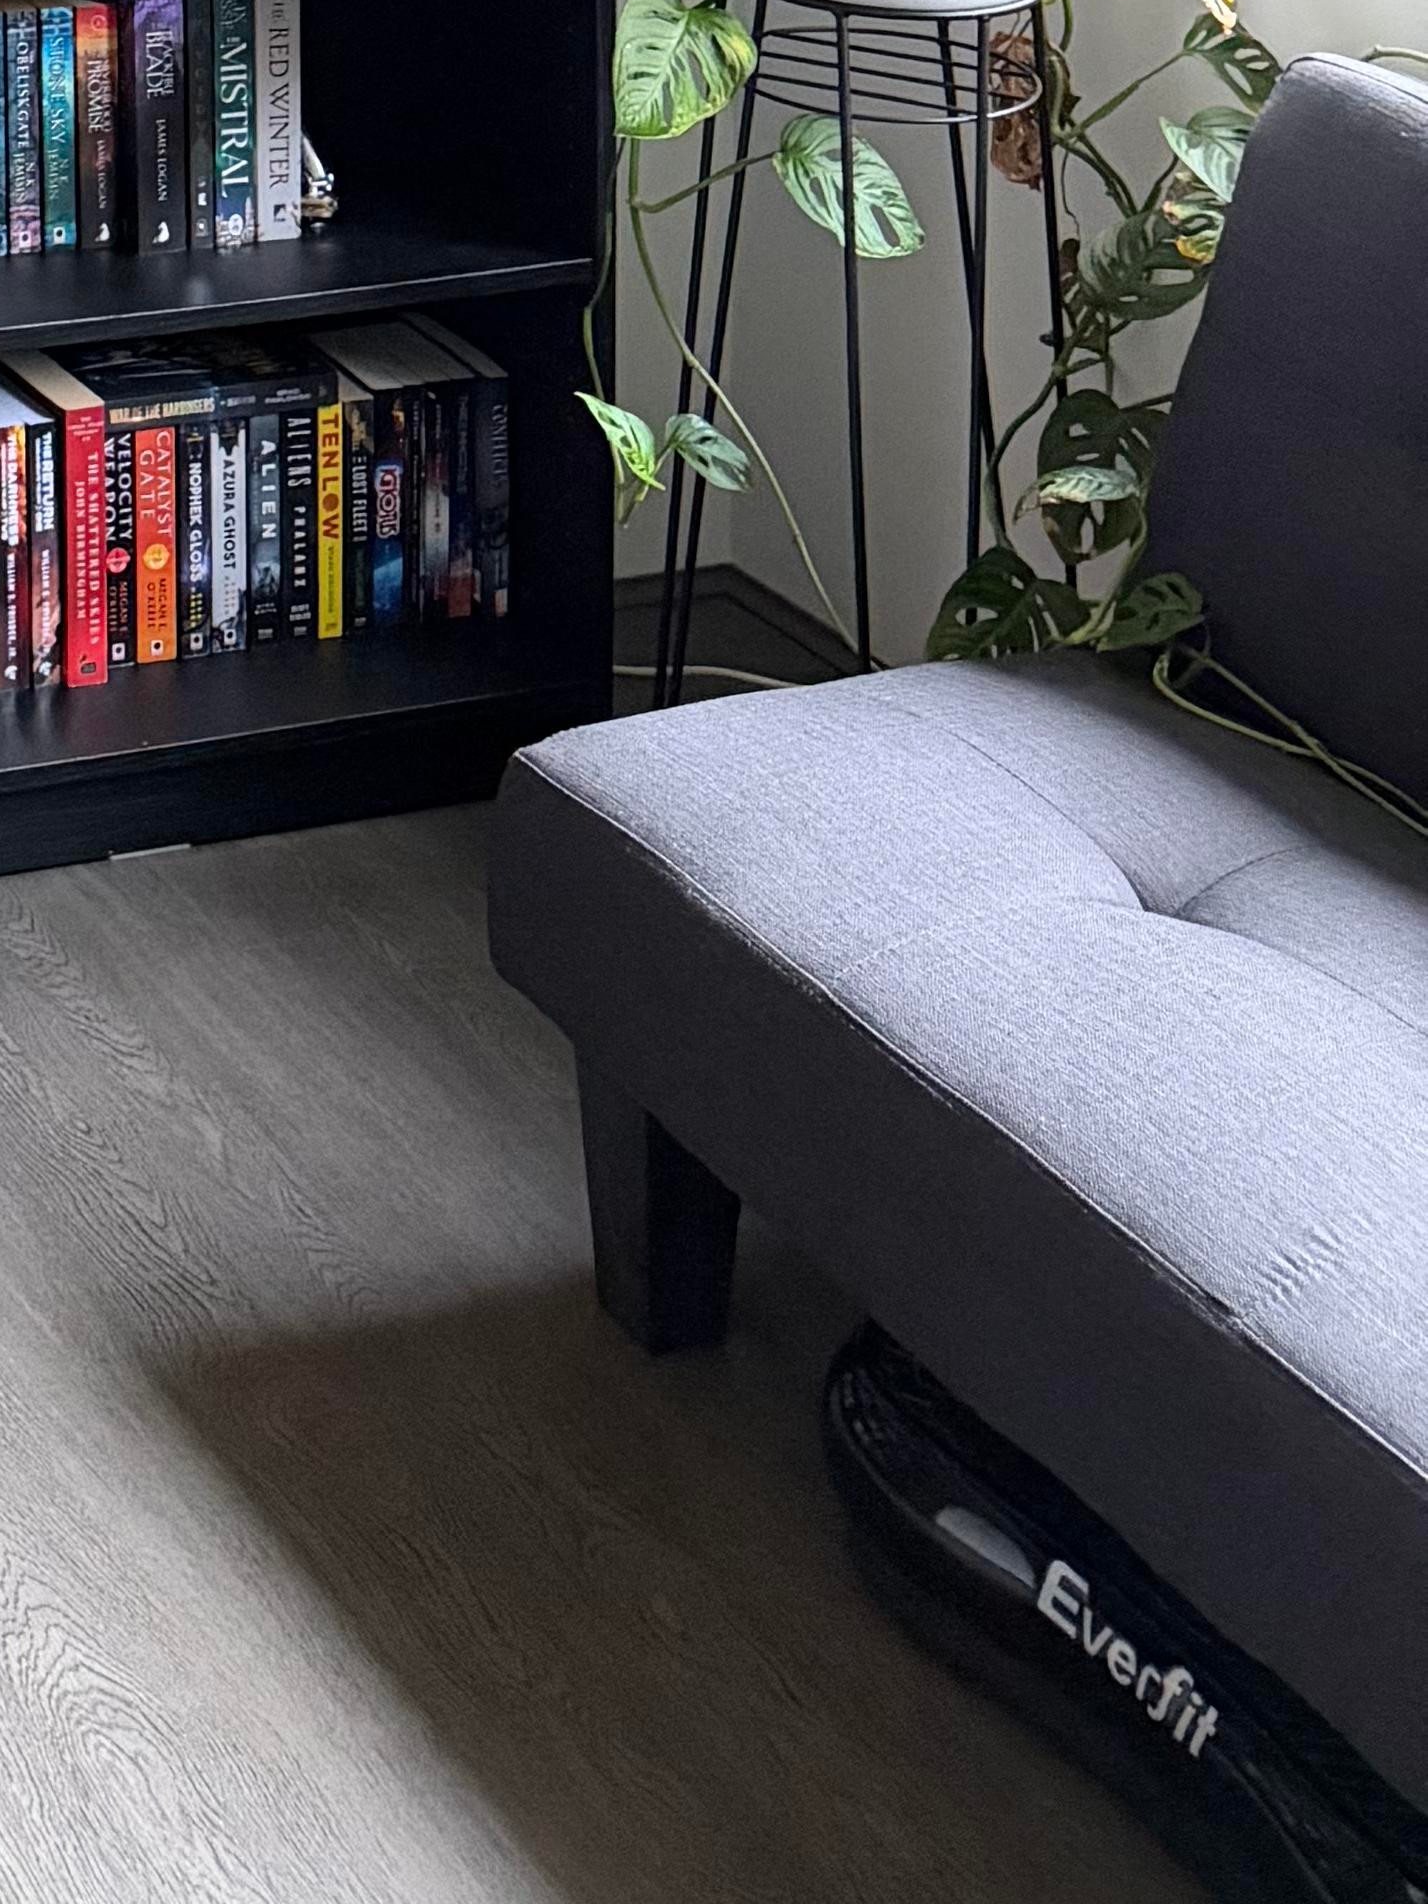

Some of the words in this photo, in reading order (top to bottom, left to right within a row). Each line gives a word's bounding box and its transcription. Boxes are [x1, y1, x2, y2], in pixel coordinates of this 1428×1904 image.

[269, 28, 289, 77] RED
[220, 42, 248, 198] MISTRAL
[269, 84, 290, 188] WINTER
[156, 431, 173, 536] CATALYST
[223, 460, 236, 513] AZURA
[260, 440, 276, 539] ALIEN
[223, 517, 236, 570] GHOST
[1037, 1560, 1219, 1757] Everfit
